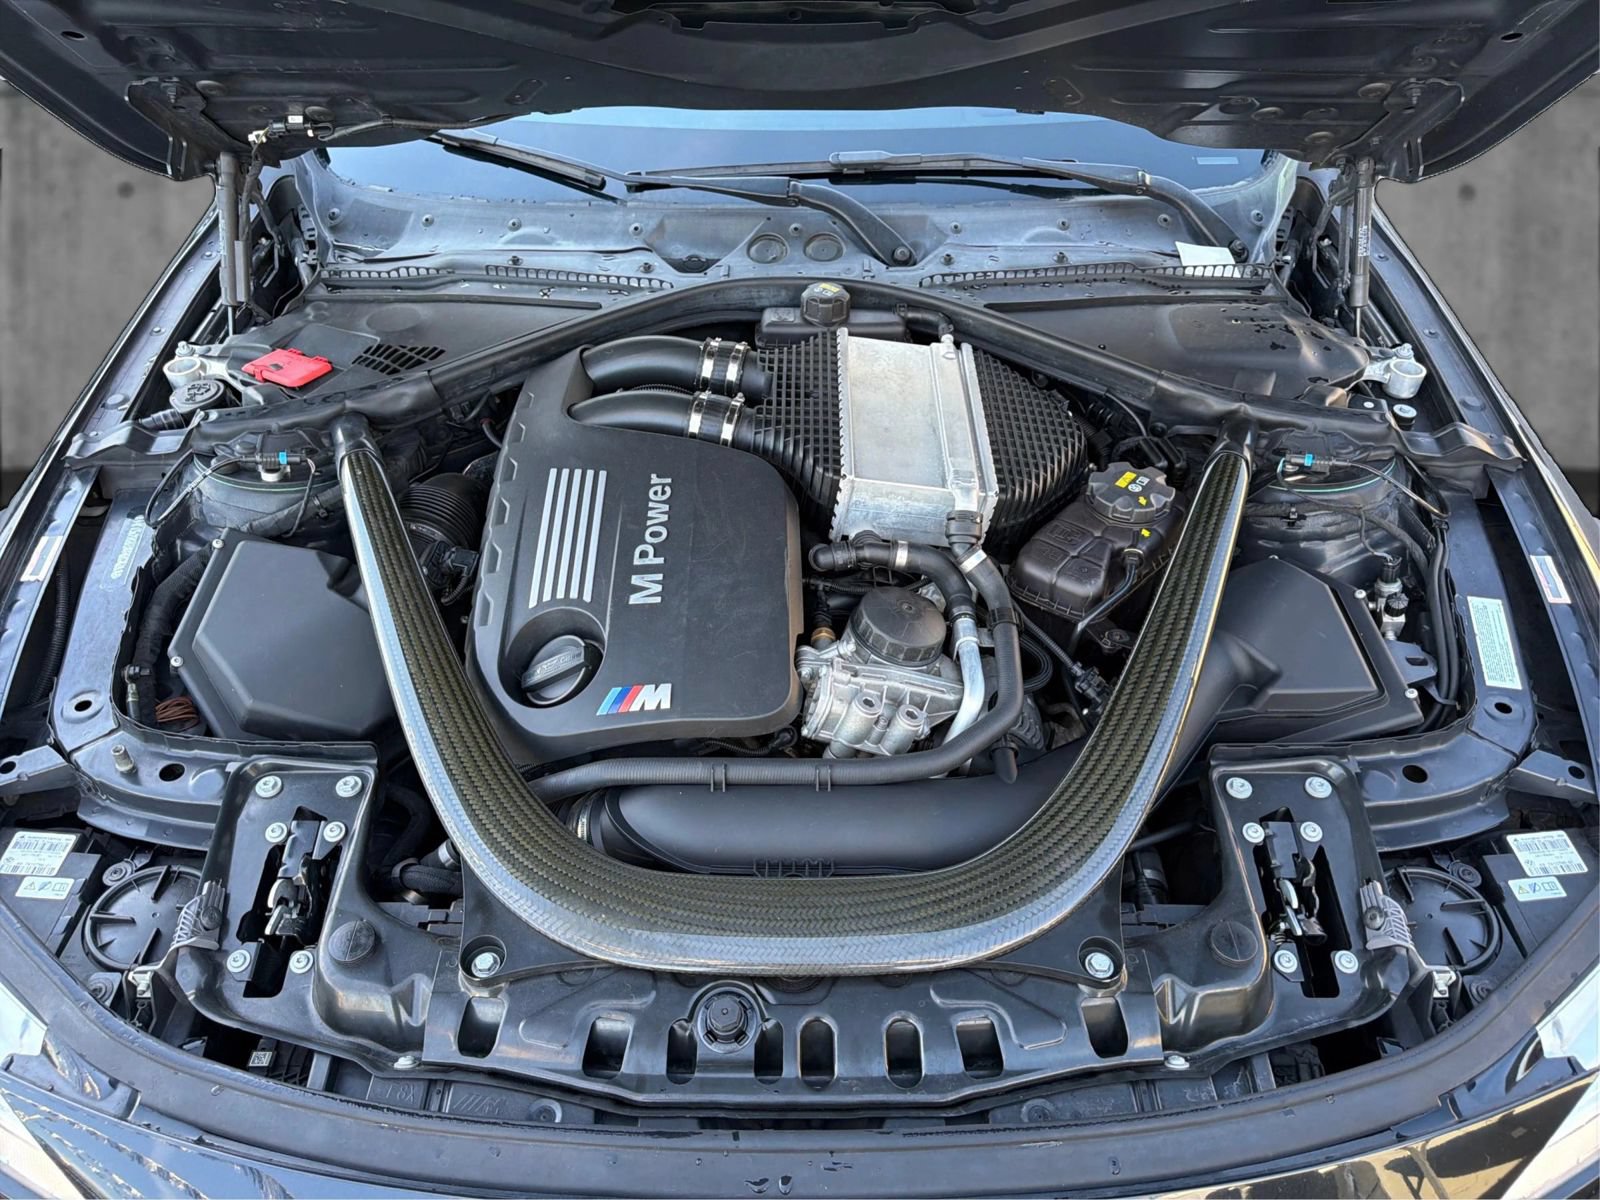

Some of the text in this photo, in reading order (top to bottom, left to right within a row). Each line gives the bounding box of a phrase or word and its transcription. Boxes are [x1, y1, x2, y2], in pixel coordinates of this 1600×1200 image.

[628, 473, 672, 606] M Power
[629, 683, 672, 712] M
